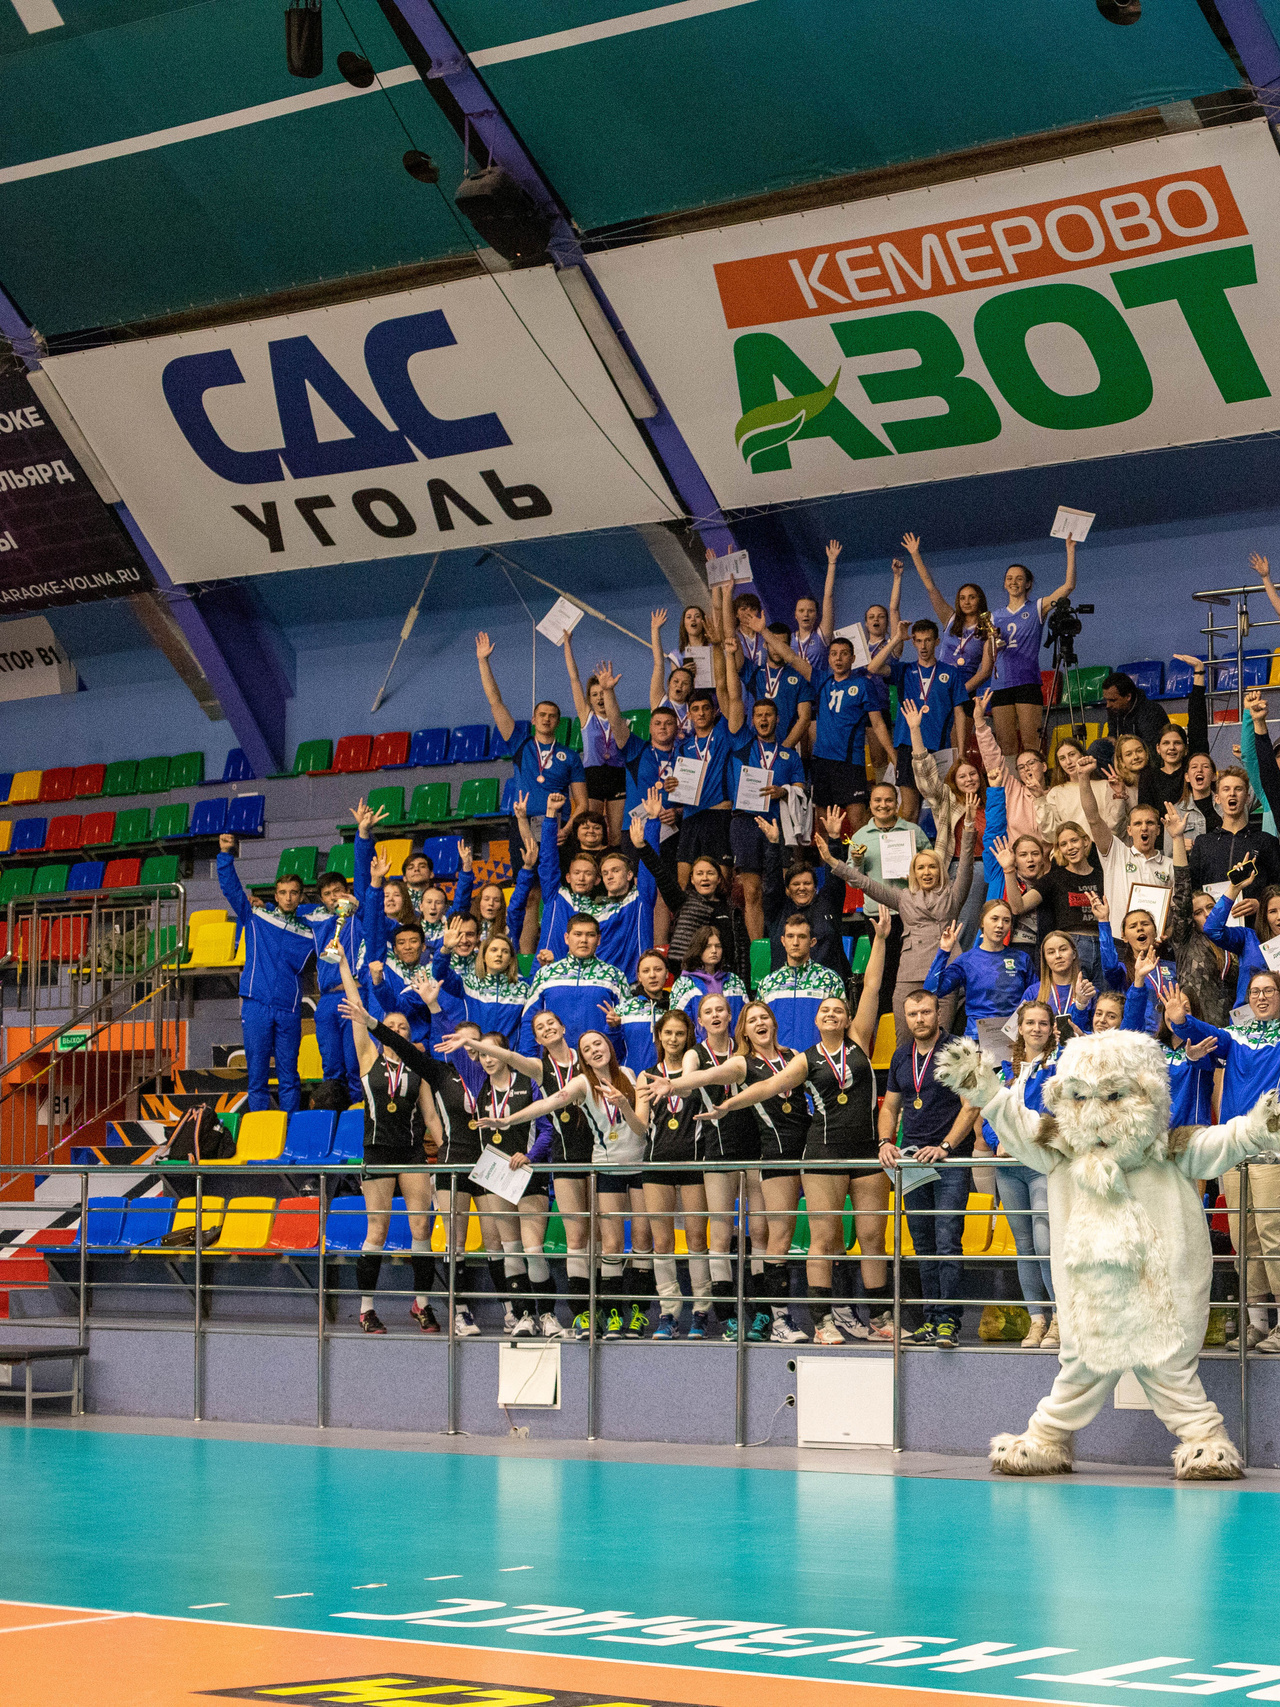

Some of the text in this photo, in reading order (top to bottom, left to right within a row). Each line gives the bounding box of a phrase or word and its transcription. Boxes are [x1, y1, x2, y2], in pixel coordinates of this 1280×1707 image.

[788, 180, 1220, 310] КЕМЕРОВО
[162, 309, 513, 484] СДС
[733, 244, 1272, 475] АЗОТ
[232, 469, 553, 553] УГОЛЬ
[0, 567, 140, 603] ARAOKE-VOLNA.RU
[329, 1598, 1079, 1673] КУЗБАСС
